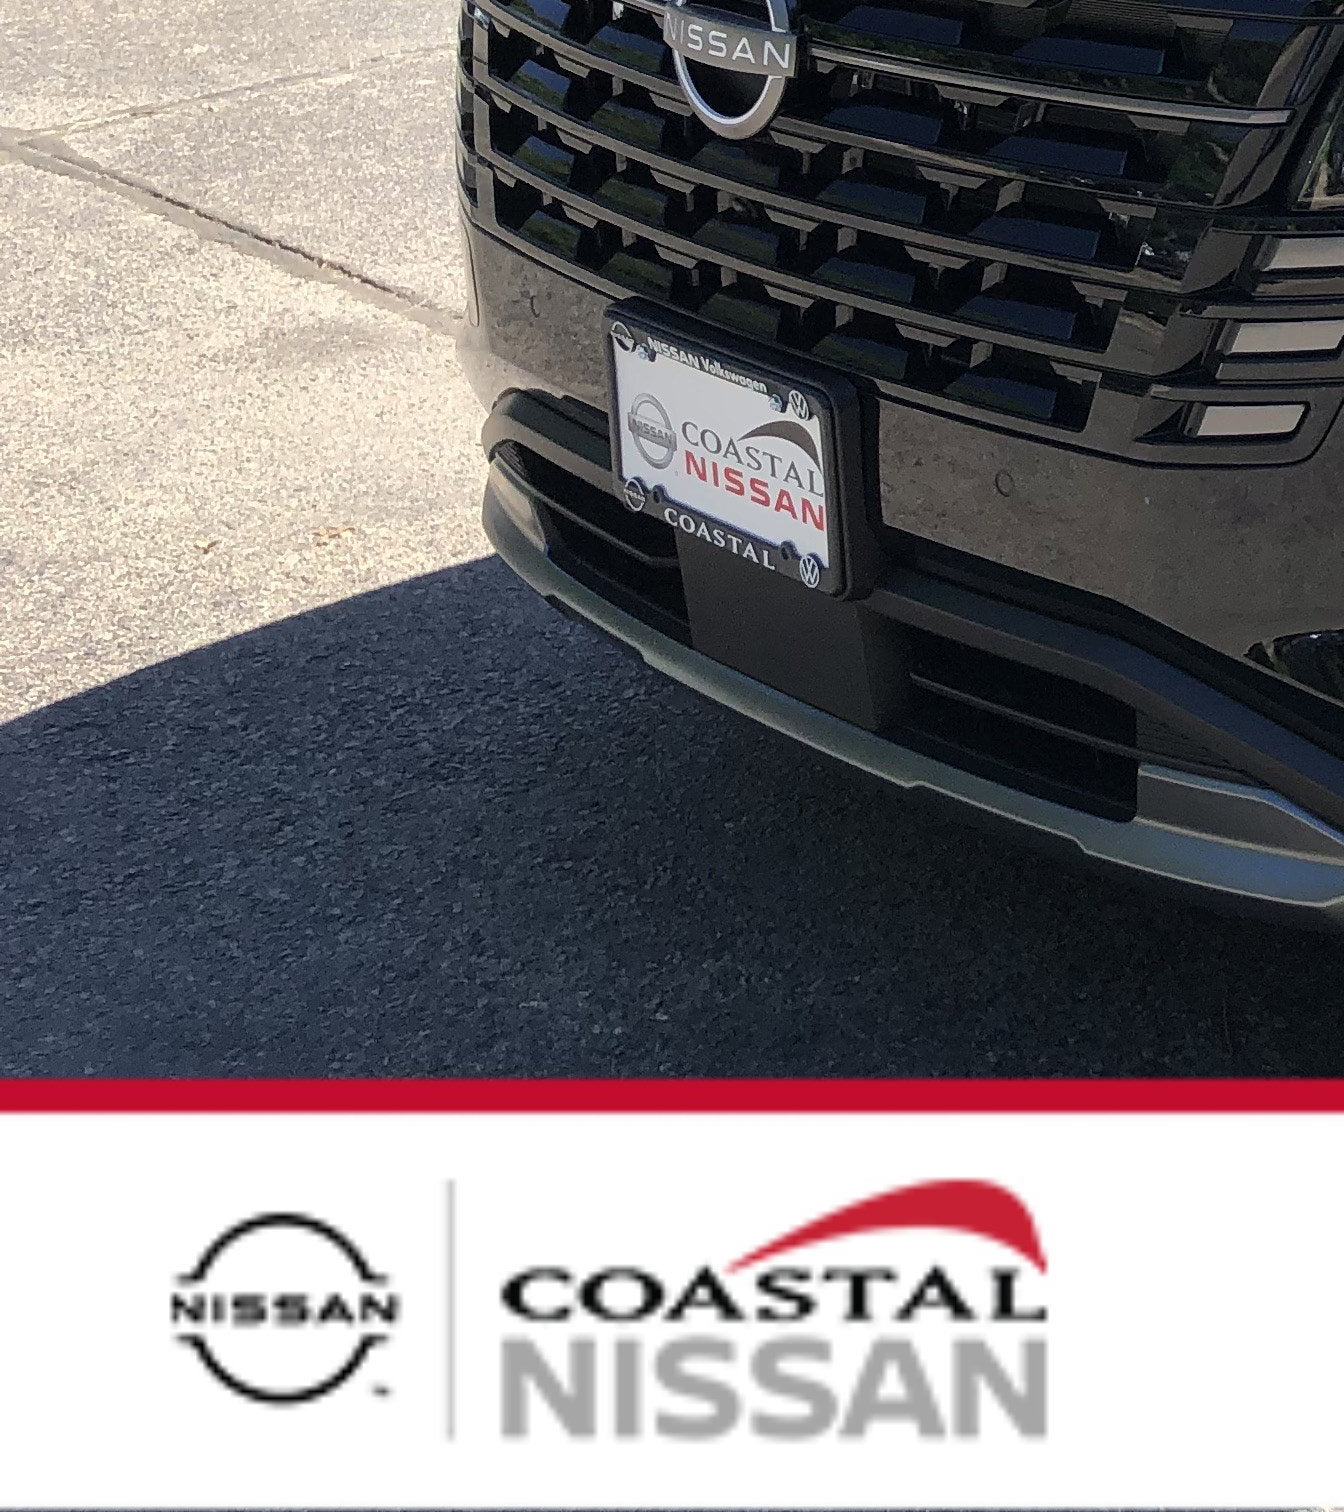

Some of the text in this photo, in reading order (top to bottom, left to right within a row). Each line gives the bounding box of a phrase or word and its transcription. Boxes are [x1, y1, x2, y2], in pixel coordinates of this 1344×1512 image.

[665, 11, 790, 69] NISSAN
[647, 337, 699, 369] NISSAN
[700, 356, 768, 393] Volkswagen
[632, 419, 673, 443] NISSAN
[681, 421, 824, 498] COASTAL
[685, 450, 825, 531] NISSAN
[664, 507, 776, 570] COASTAL
